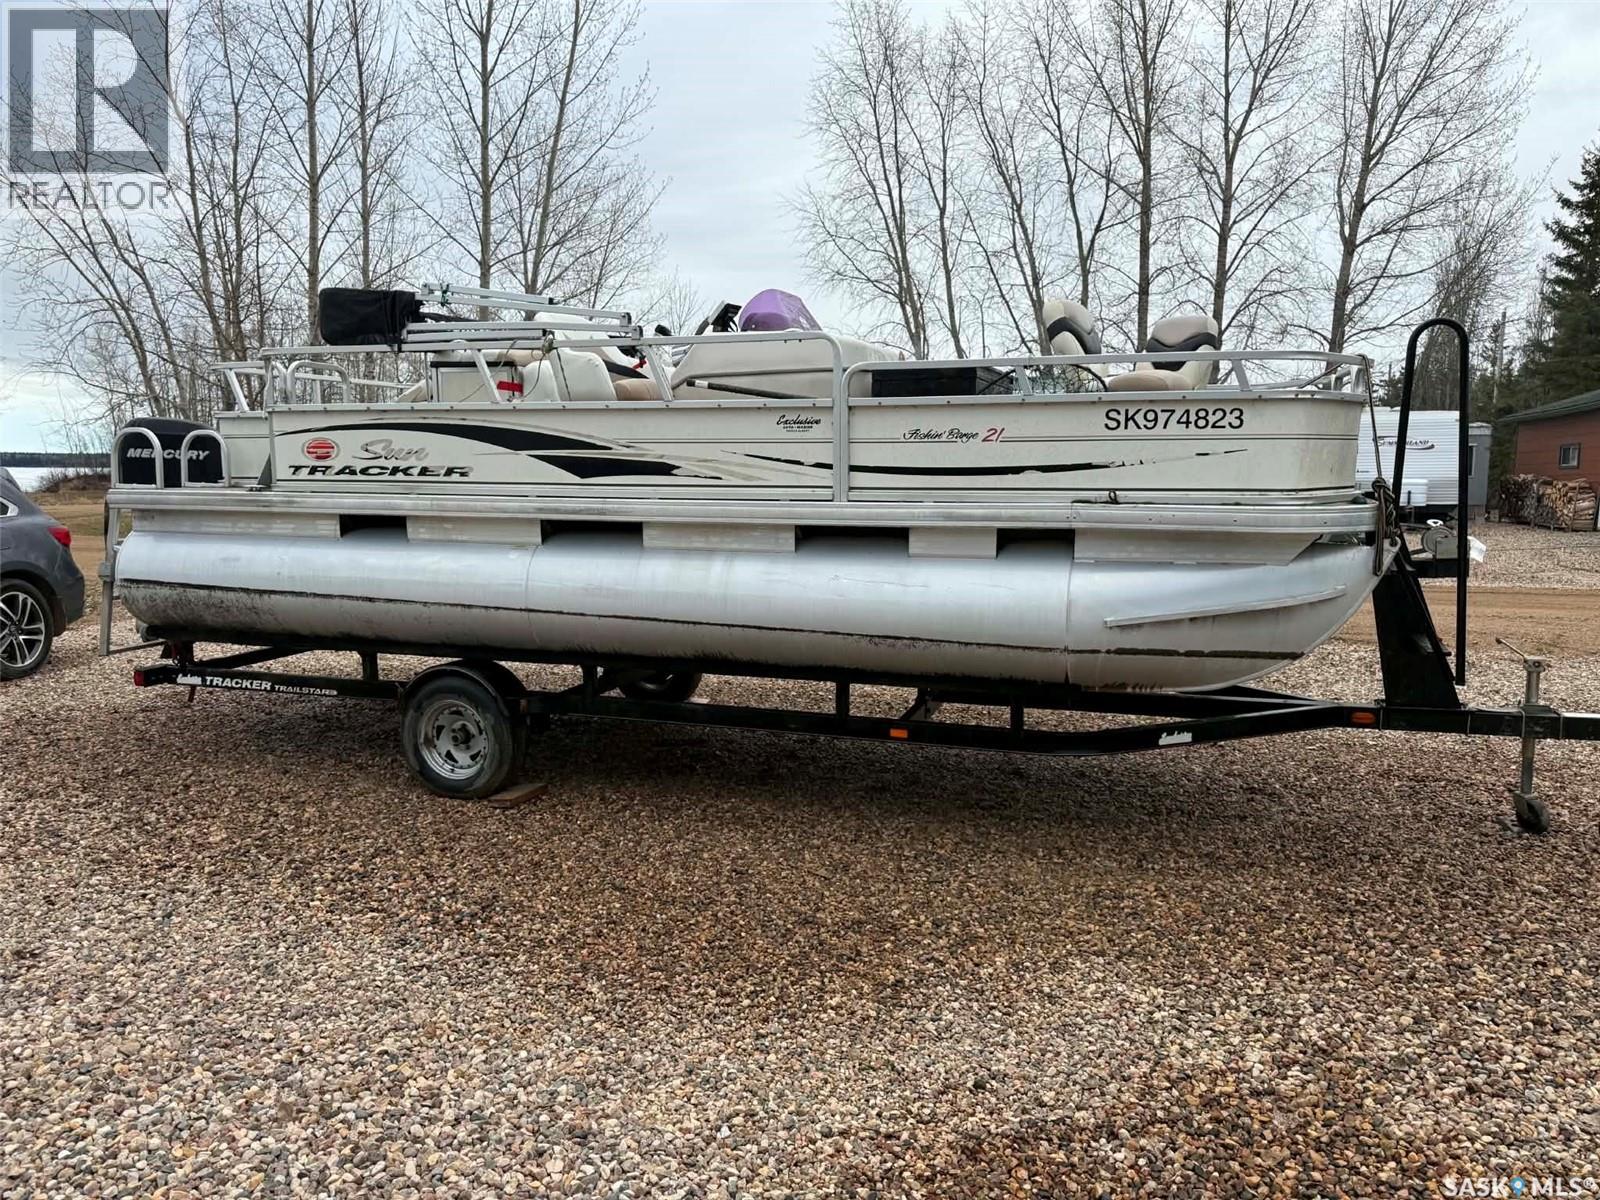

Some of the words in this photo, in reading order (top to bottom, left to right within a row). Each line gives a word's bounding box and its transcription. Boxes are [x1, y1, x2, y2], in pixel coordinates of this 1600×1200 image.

[1104, 407, 1245, 430] SK974823
[946, 427, 979, 443] Barge
[981, 427, 1005, 442] 21
[288, 465, 474, 478] TRACKER
[205, 676, 272, 691] TRACKER
